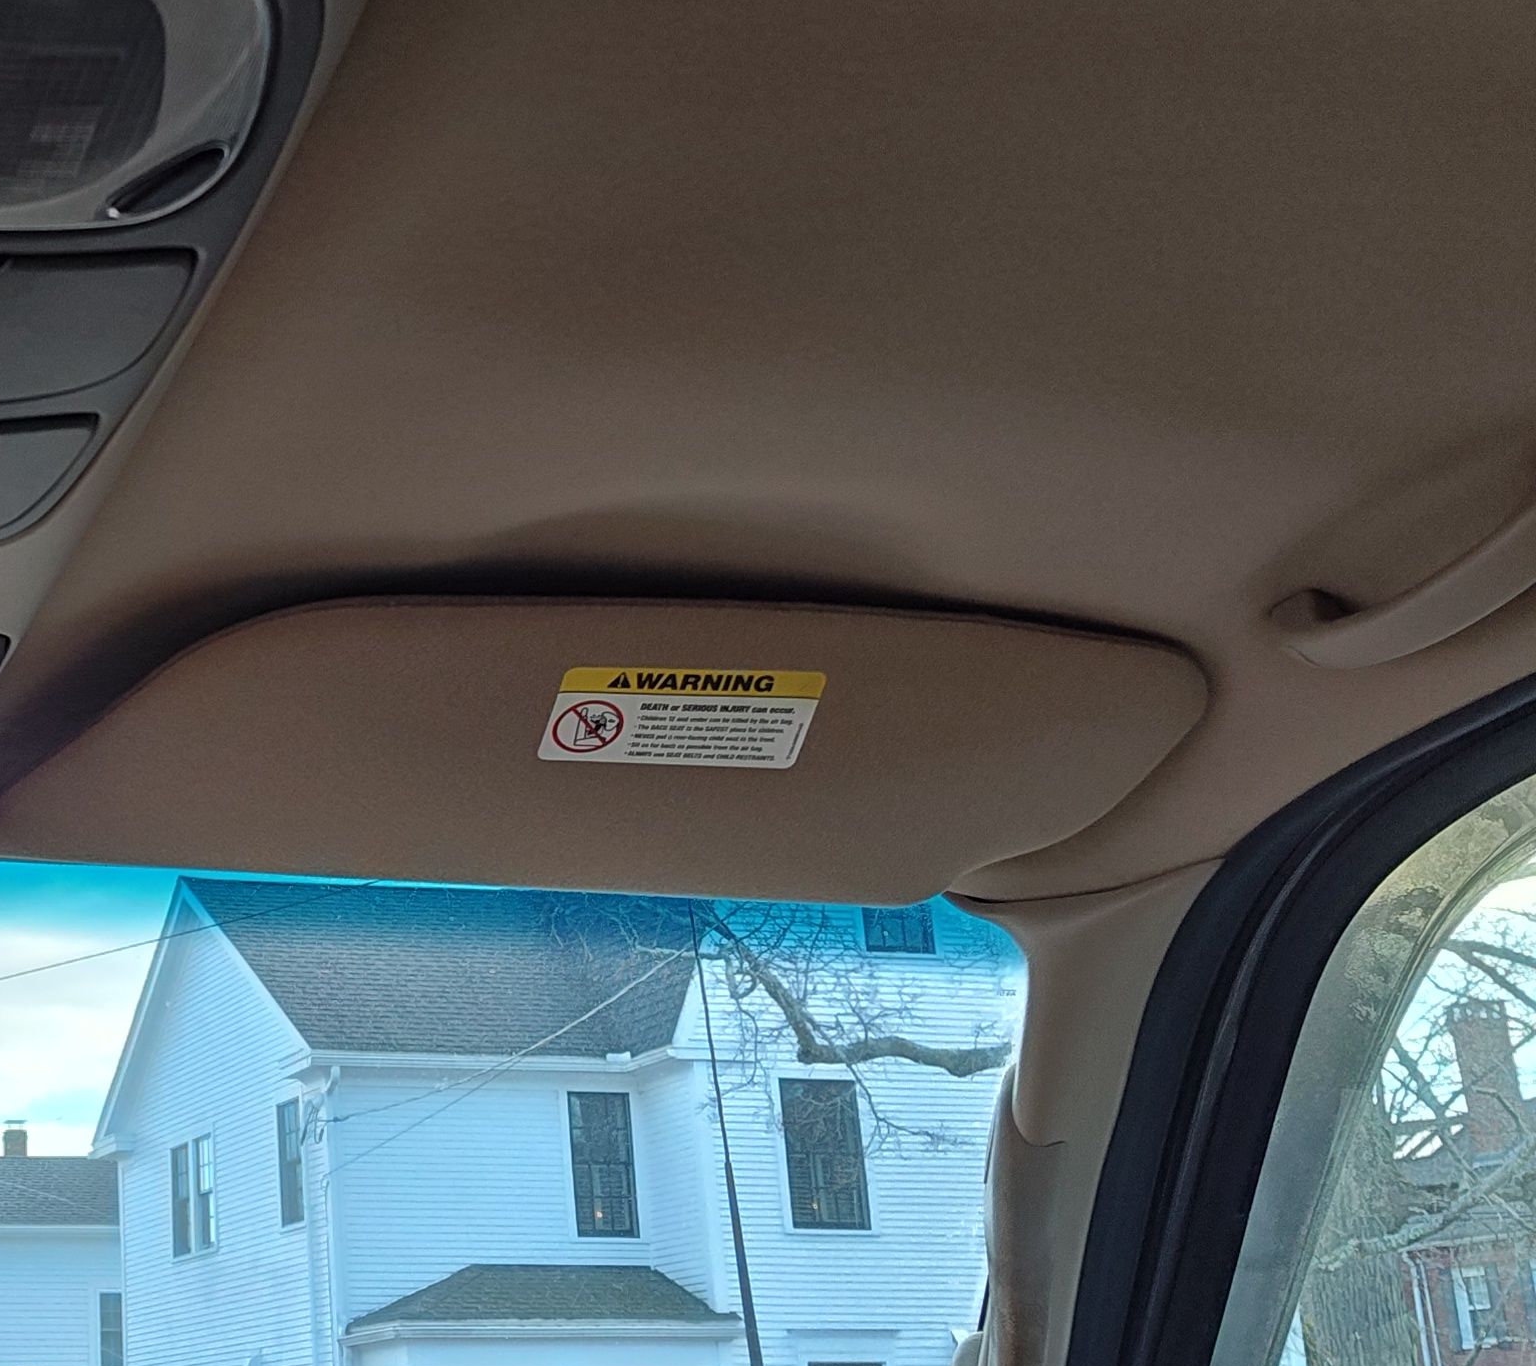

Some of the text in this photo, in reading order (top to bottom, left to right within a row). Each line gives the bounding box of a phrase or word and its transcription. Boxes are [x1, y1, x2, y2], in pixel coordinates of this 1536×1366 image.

[636, 672, 775, 693] WARNING
[640, 703, 669, 711] DEATH
[681, 704, 718, 712] SERIOUS
[719, 705, 751, 713] INJURY
